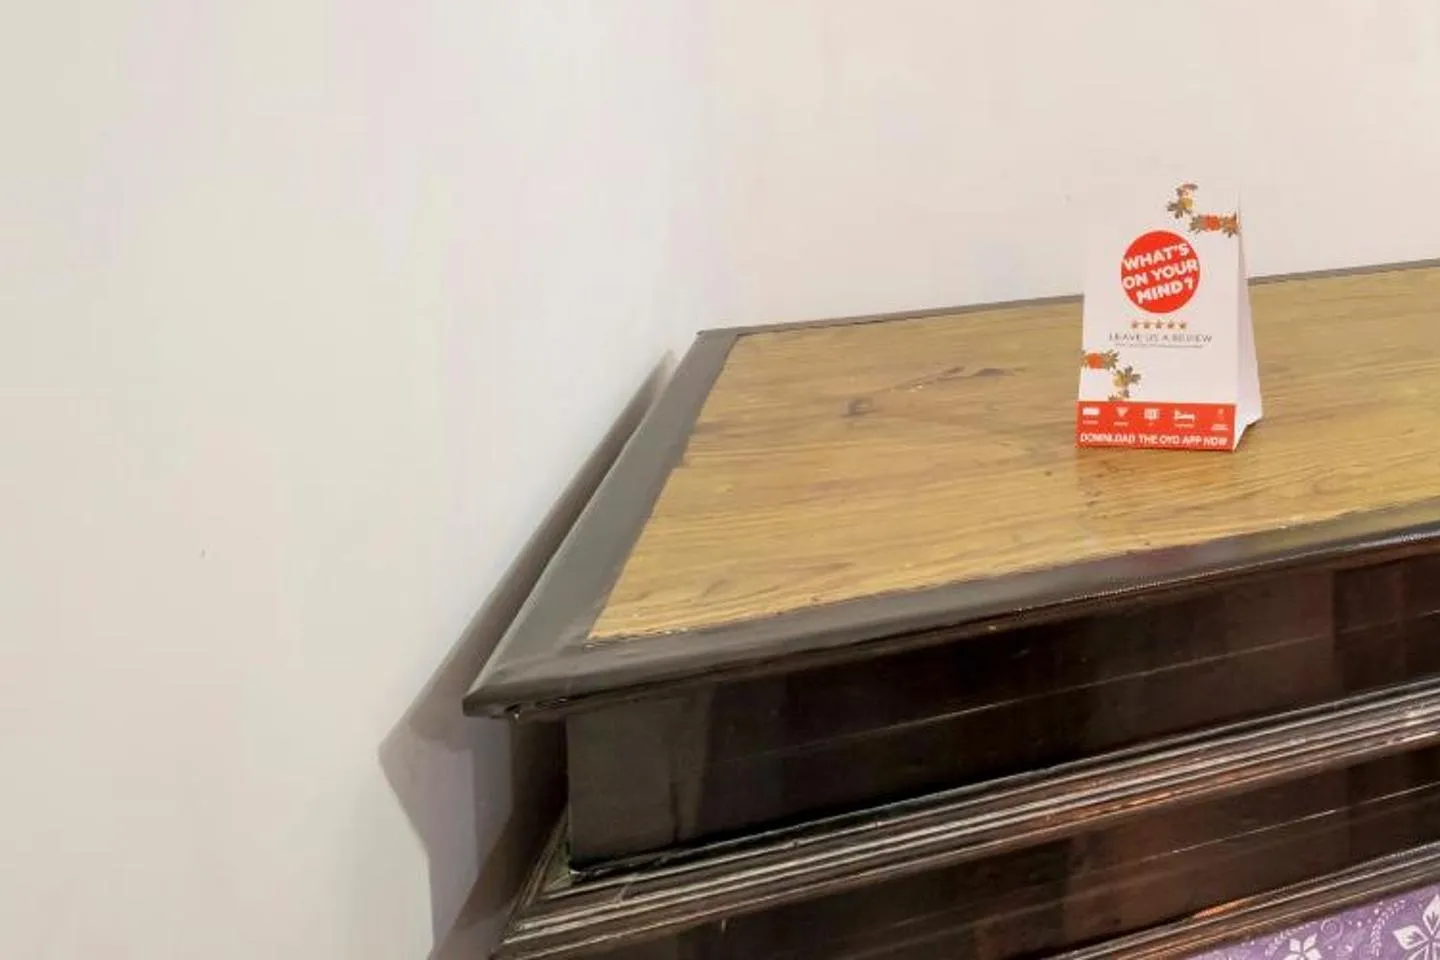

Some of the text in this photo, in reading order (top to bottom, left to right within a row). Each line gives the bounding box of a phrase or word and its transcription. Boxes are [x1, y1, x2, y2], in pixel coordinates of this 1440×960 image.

[1124, 243, 1190, 271] WHAT'S
[1123, 258, 1199, 290] ON YOUR
[1109, 332, 1141, 342] LEAVE
[1162, 333, 1169, 342] A
[1172, 333, 1213, 343] REVIEW
[1080, 432, 1228, 446] DOWNLOAD THE OYO APP NOW
